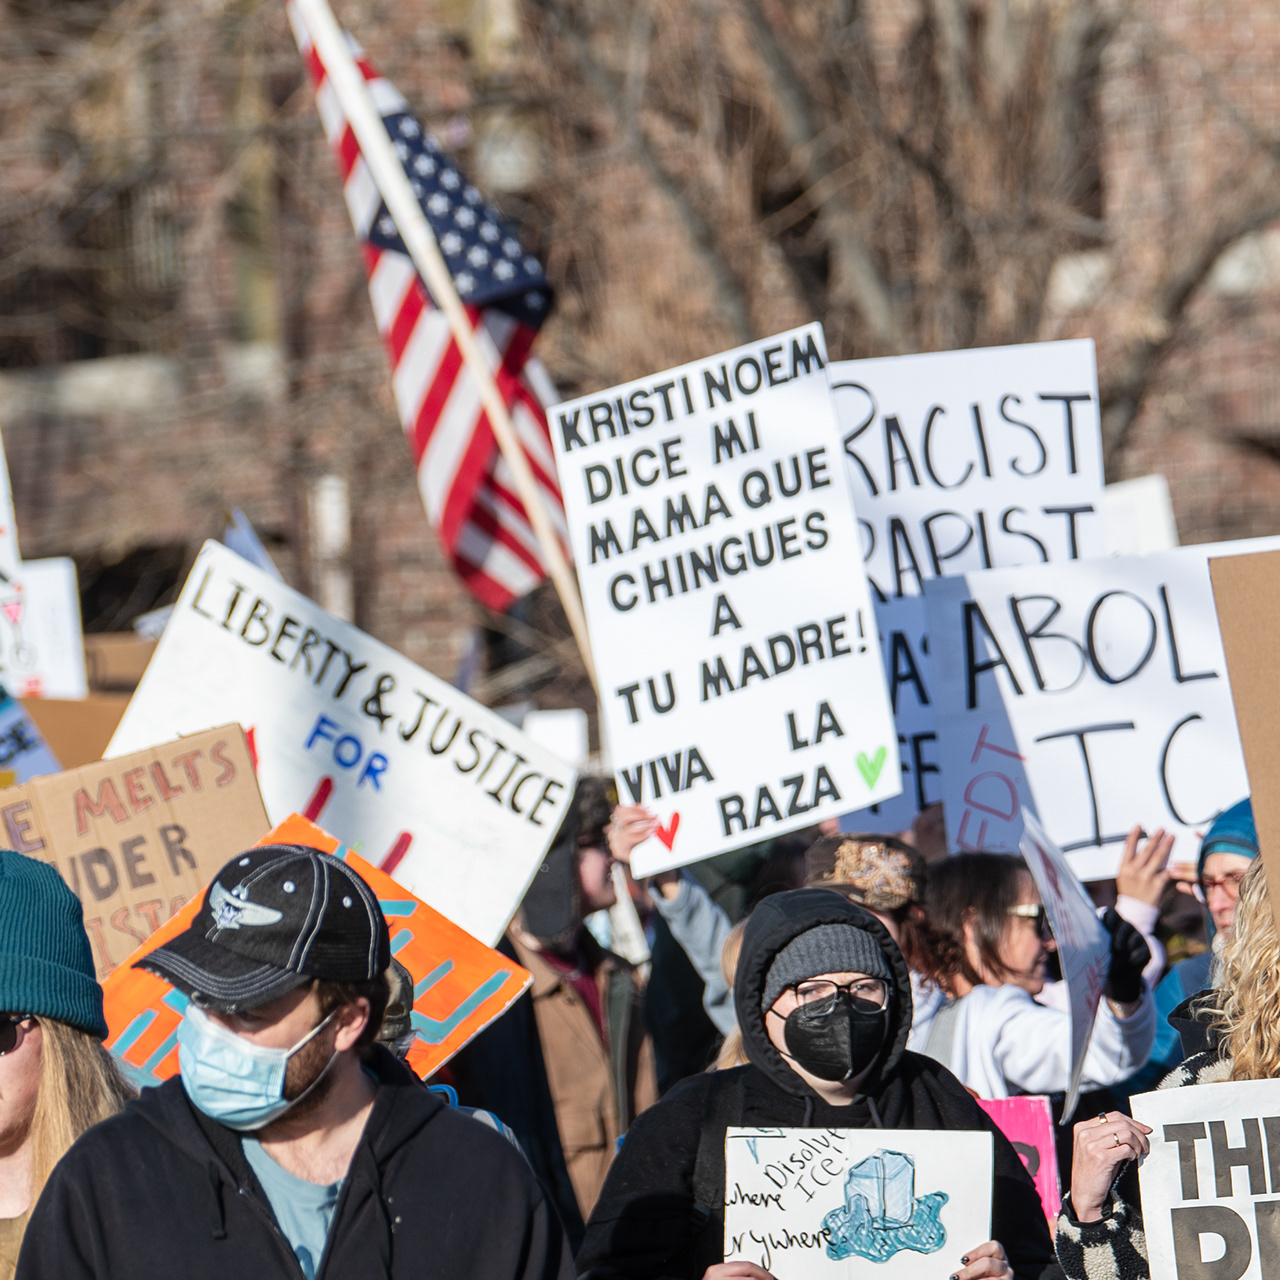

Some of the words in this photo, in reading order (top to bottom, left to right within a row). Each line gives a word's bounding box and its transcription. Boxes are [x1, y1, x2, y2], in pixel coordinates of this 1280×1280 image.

[558, 376, 697, 453] KRISTI
[705, 334, 827, 408] NOEM
[831, 381, 1092, 498] RACIST
[583, 438, 688, 505] DICE
[713, 411, 762, 465] MI
[588, 485, 733, 566] MAMA
[742, 447, 831, 512] QUE
[609, 510, 830, 613] CHINGUES
[616, 671, 677, 725] TU
[700, 609, 869, 702] MADRE!
[711, 593, 742, 639] A
[189, 565, 368, 701] LIBERTY
[358, 672, 397, 734] &
[400, 688, 567, 829] JUSTICE
[72, 739, 238, 839] MELTS
[304, 714, 390, 793] FOR
[620, 746, 715, 804] VIVA
[785, 700, 845, 752] LA
[717, 764, 843, 838] RAZA
